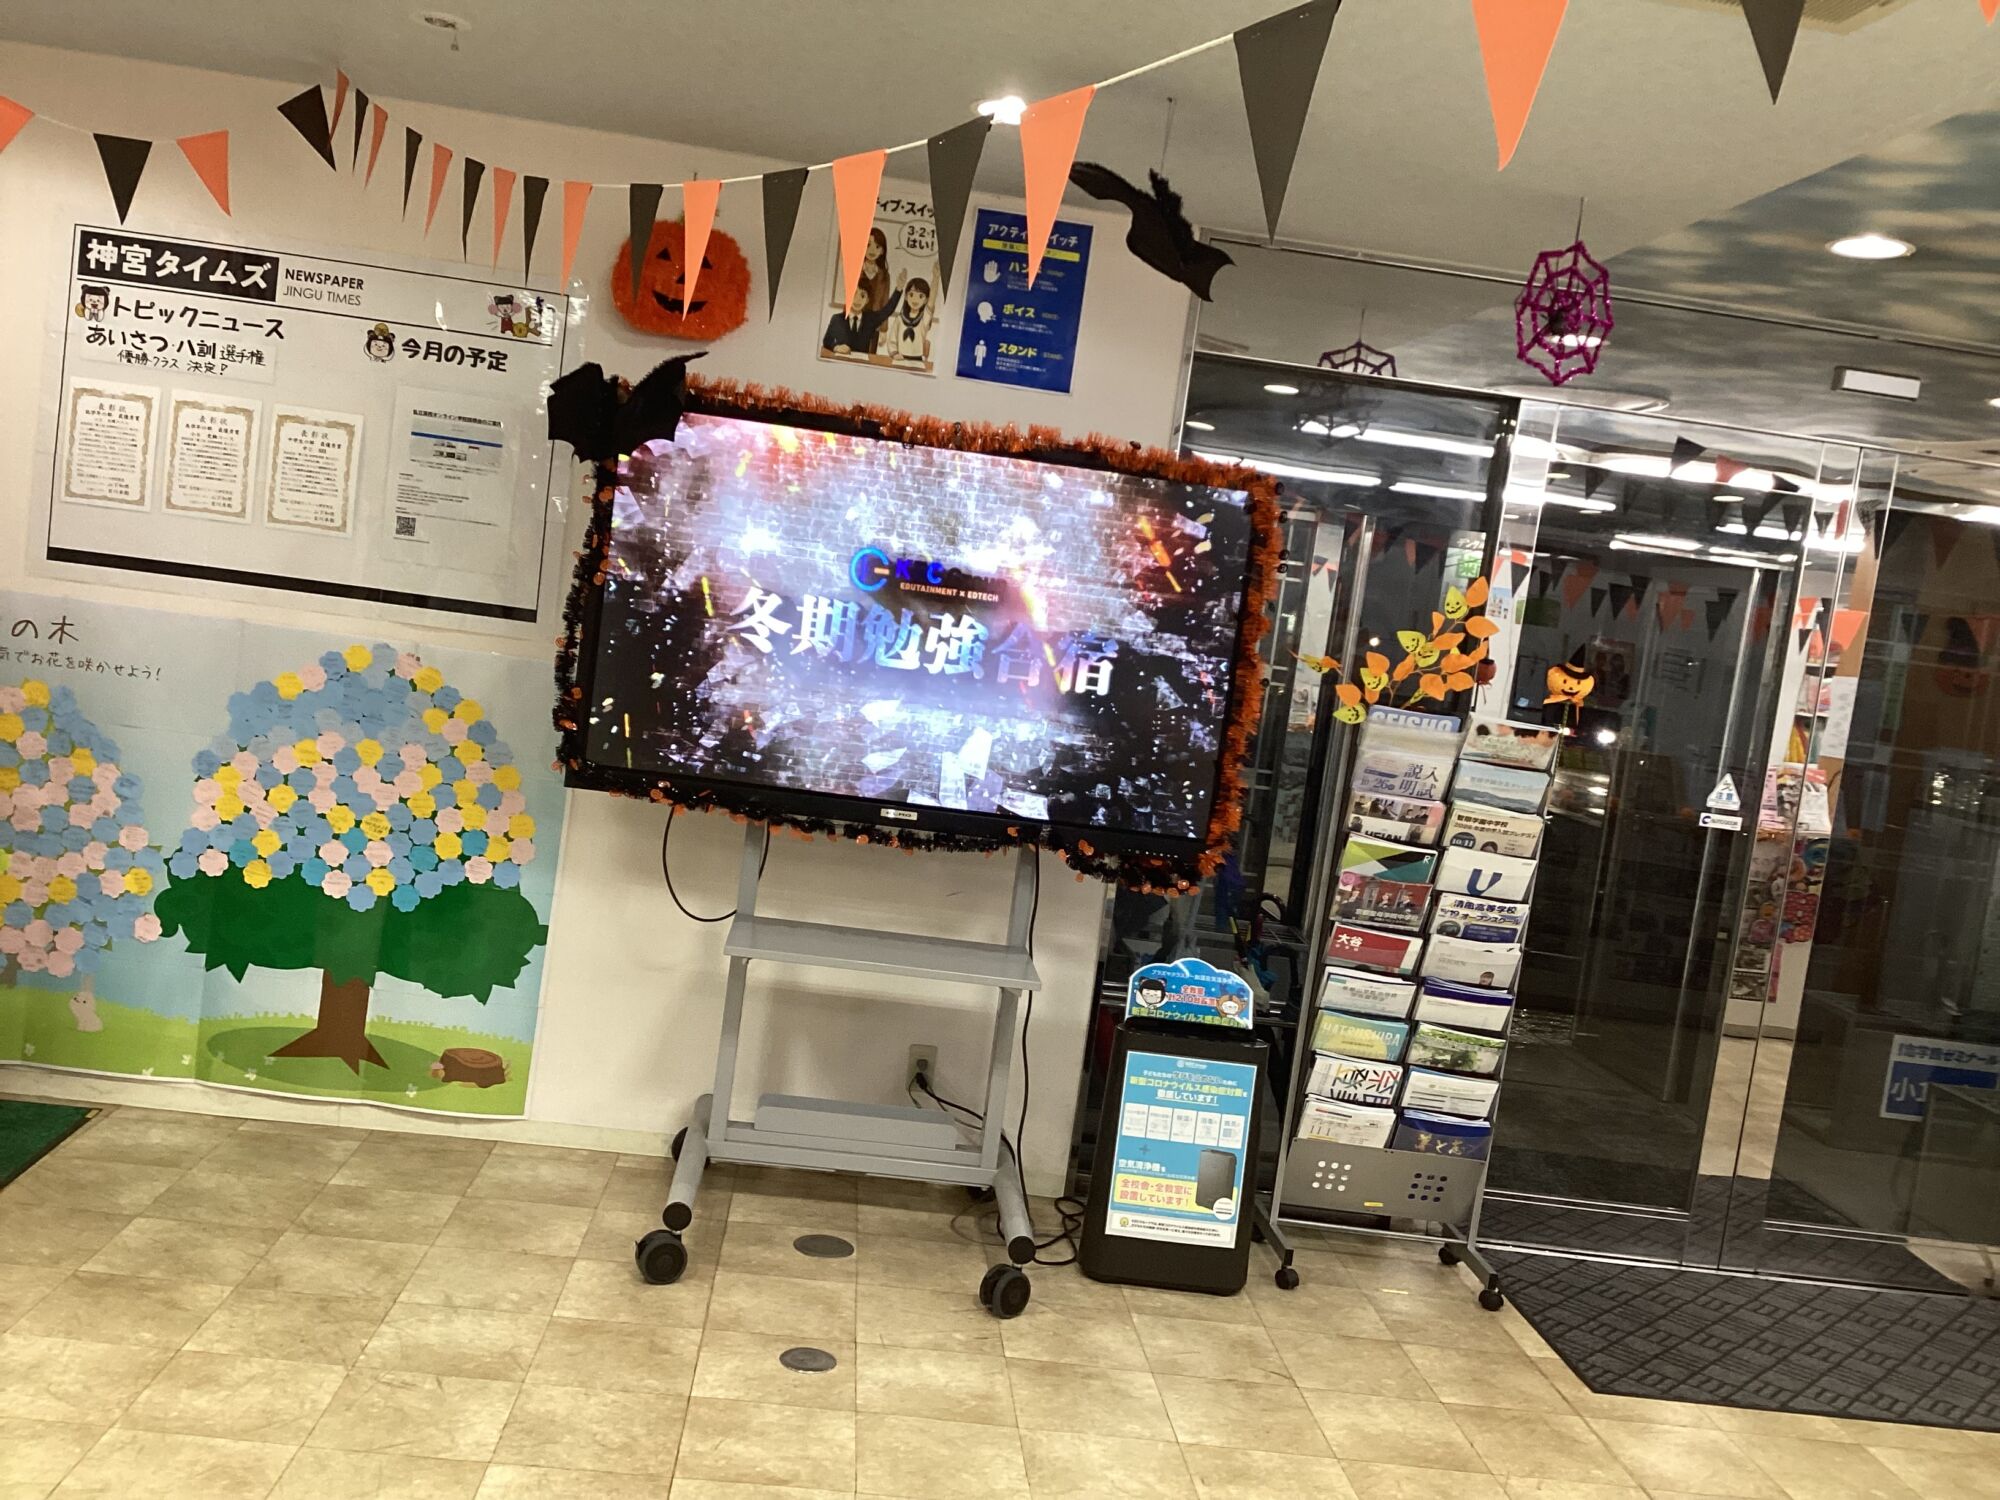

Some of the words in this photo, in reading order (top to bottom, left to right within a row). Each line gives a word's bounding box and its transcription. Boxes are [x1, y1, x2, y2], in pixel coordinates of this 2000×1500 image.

[86, 238, 273, 290] 神宮タイムズ
[285, 268, 365, 291] NEWSPAPER
[283, 285, 323, 302] JINGU
[327, 290, 362, 307] TIMES
[113, 296, 285, 340] トピックニュース
[1002, 303, 1036, 319] ボイス
[117, 350, 180, 371] 優勝クラス
[401, 337, 509, 373] 今月の予定
[997, 342, 1038, 358] スタンド
[900, 582, 958, 597] EDUTAINMENT
[967, 591, 999, 603] EDTECH
[727, 585, 1120, 697] 冬期勉強合宿
[1337, 933, 1363, 947] 大谷
